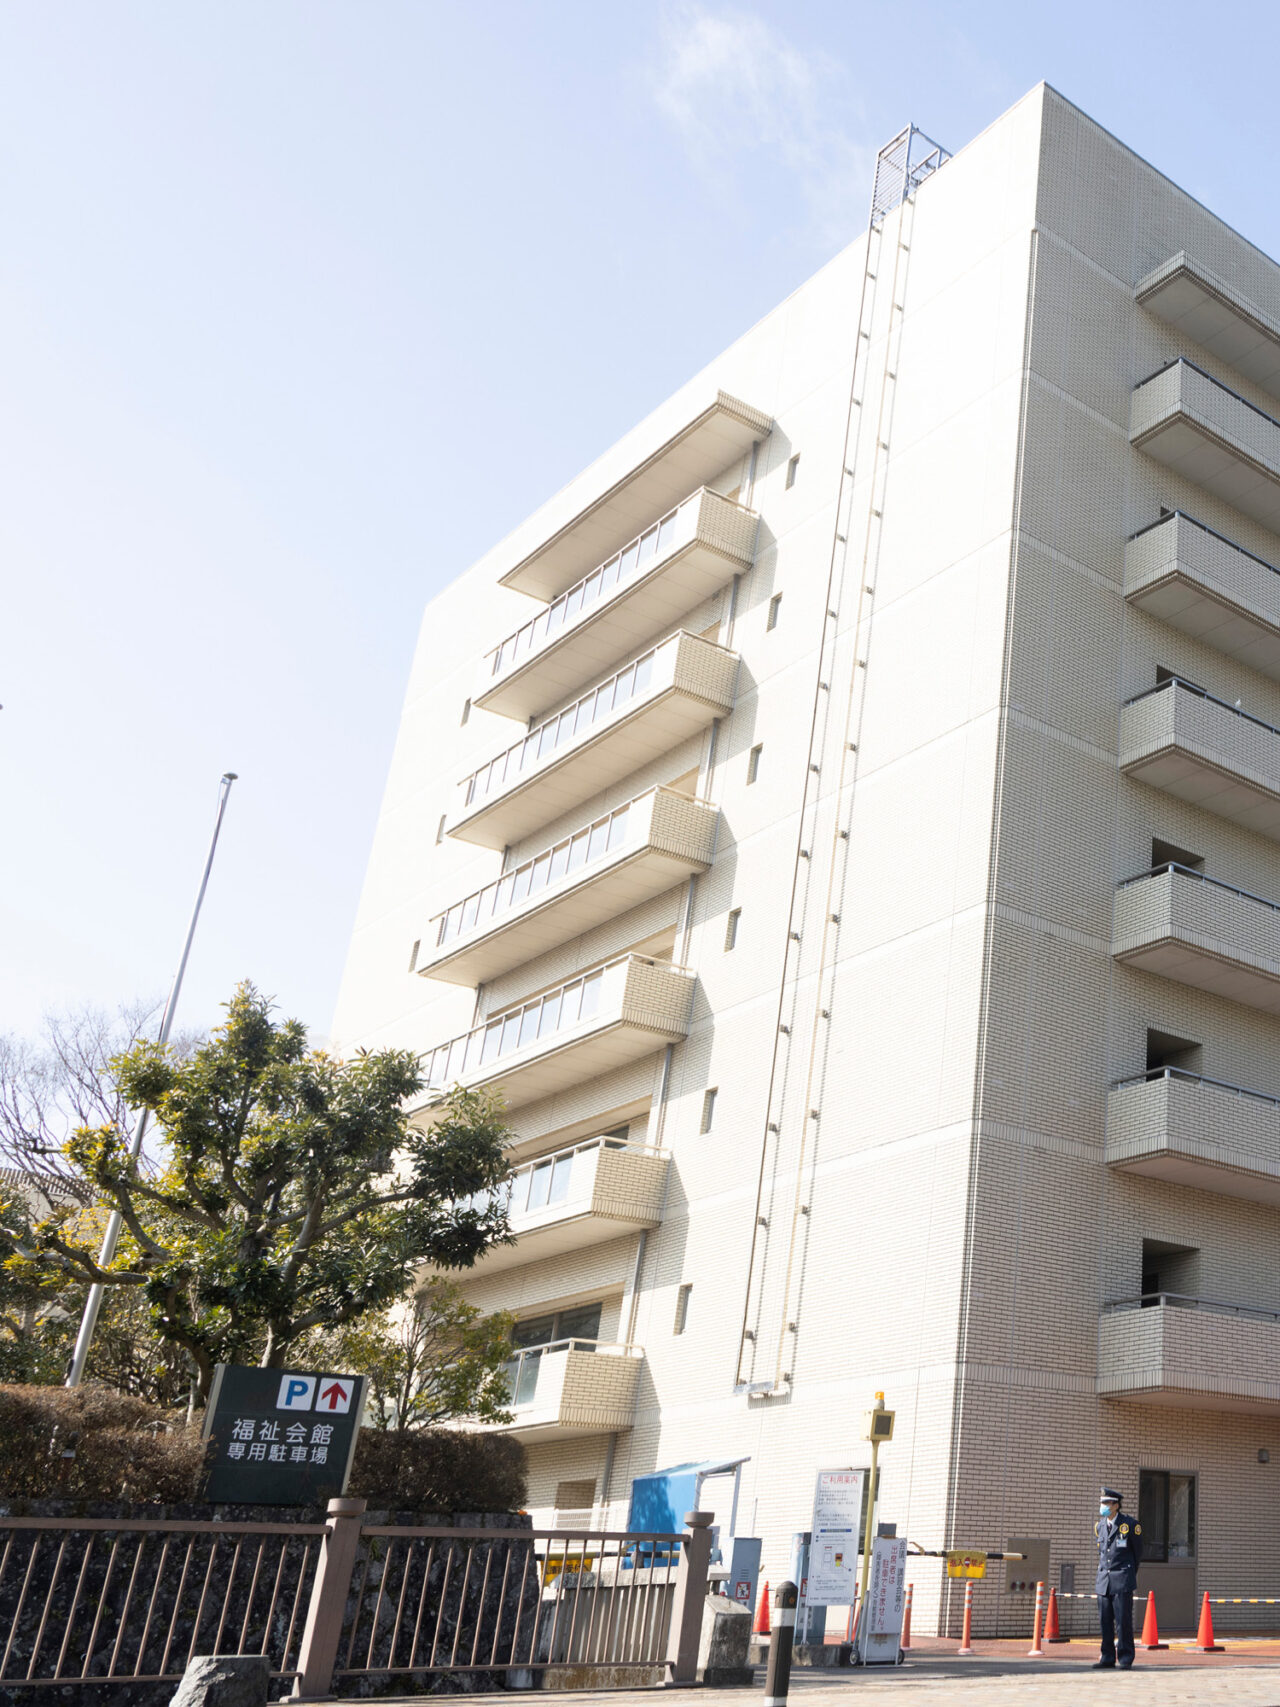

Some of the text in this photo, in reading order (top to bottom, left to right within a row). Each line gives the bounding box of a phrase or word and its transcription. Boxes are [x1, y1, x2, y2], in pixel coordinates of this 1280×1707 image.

[285, 1380, 308, 1406] P
[231, 1418, 334, 1445] 福祉会館
[227, 1442, 328, 1465] 専用駐車場
